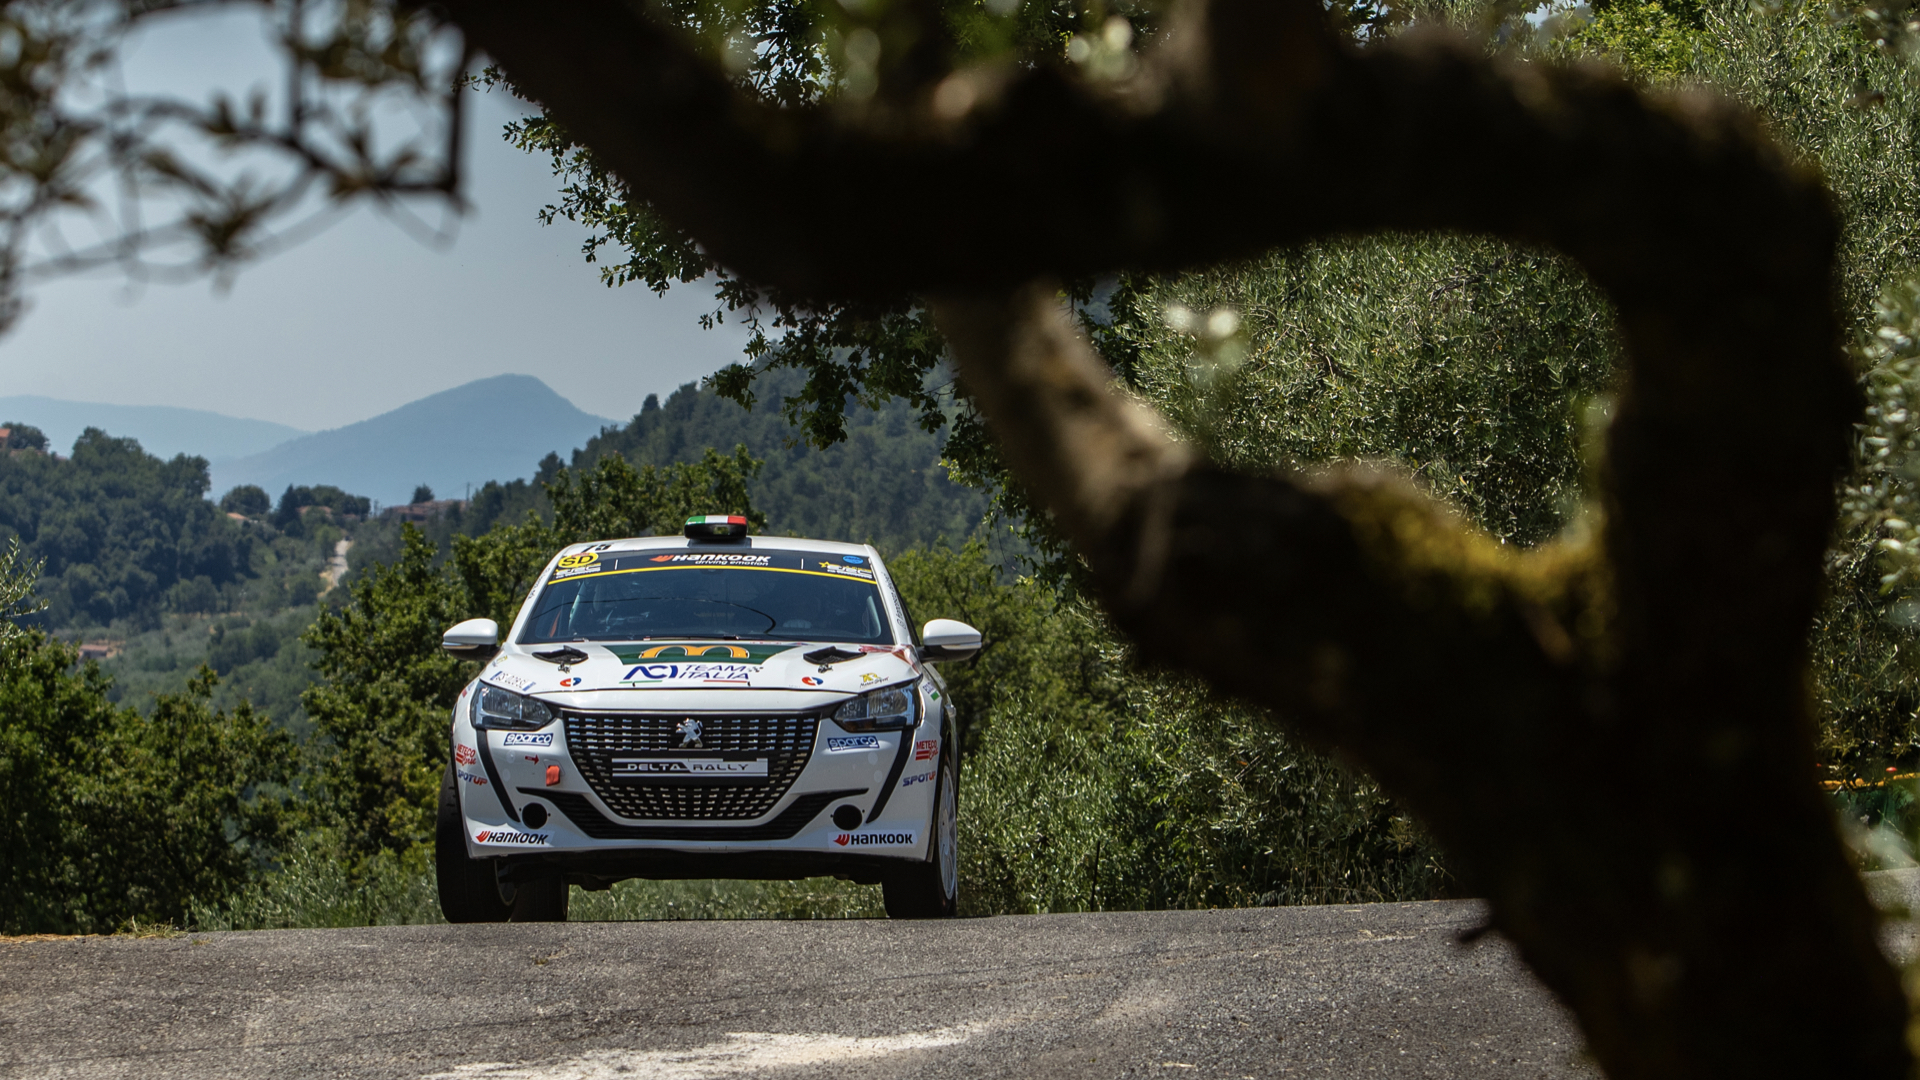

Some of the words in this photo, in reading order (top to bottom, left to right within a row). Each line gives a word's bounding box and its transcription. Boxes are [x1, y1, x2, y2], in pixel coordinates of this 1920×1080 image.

[561, 555, 594, 566] SD
[507, 733, 552, 745] sparco
[829, 736, 877, 750] sparco
[627, 763, 681, 771] DELTA
[693, 763, 749, 771] RALLY
